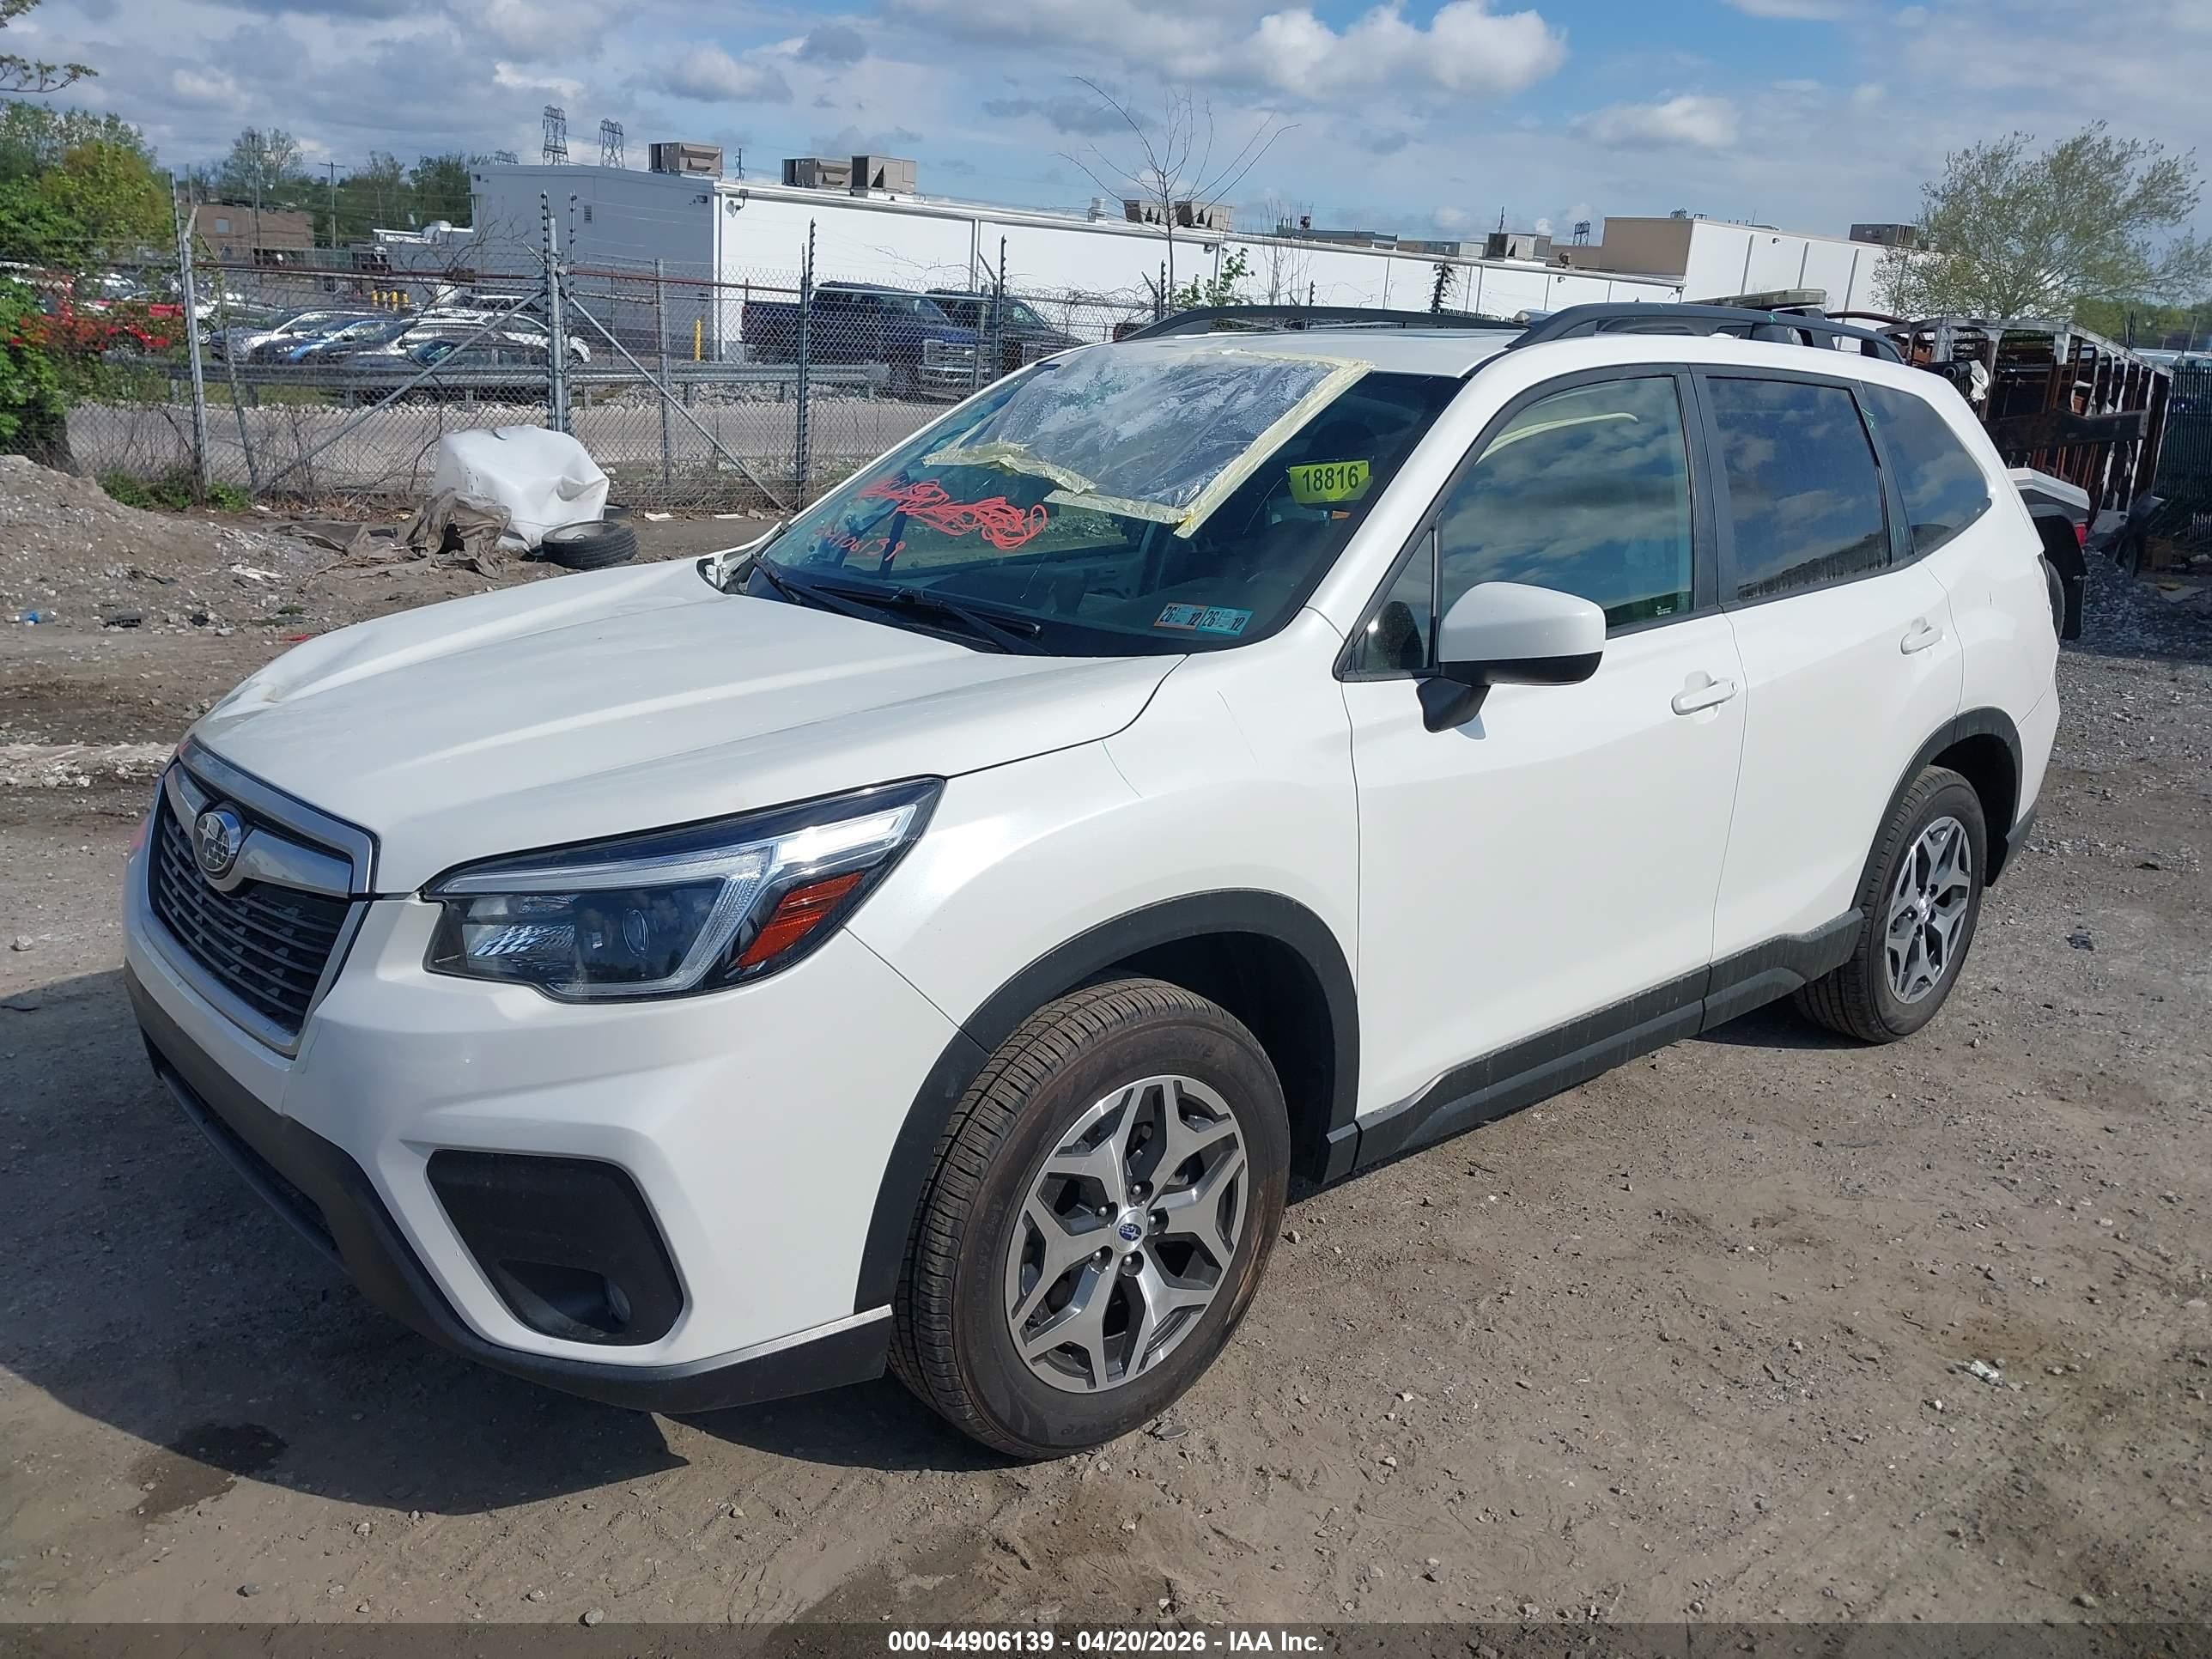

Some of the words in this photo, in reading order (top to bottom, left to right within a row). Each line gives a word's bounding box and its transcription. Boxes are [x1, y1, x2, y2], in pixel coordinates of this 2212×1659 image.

[1302, 465, 1359, 493] 18816
[1160, 606, 1176, 623] 26
[1187, 612, 1202, 626] 12
[1202, 611, 1219, 628] 26
[1230, 617, 1245, 631] 12
